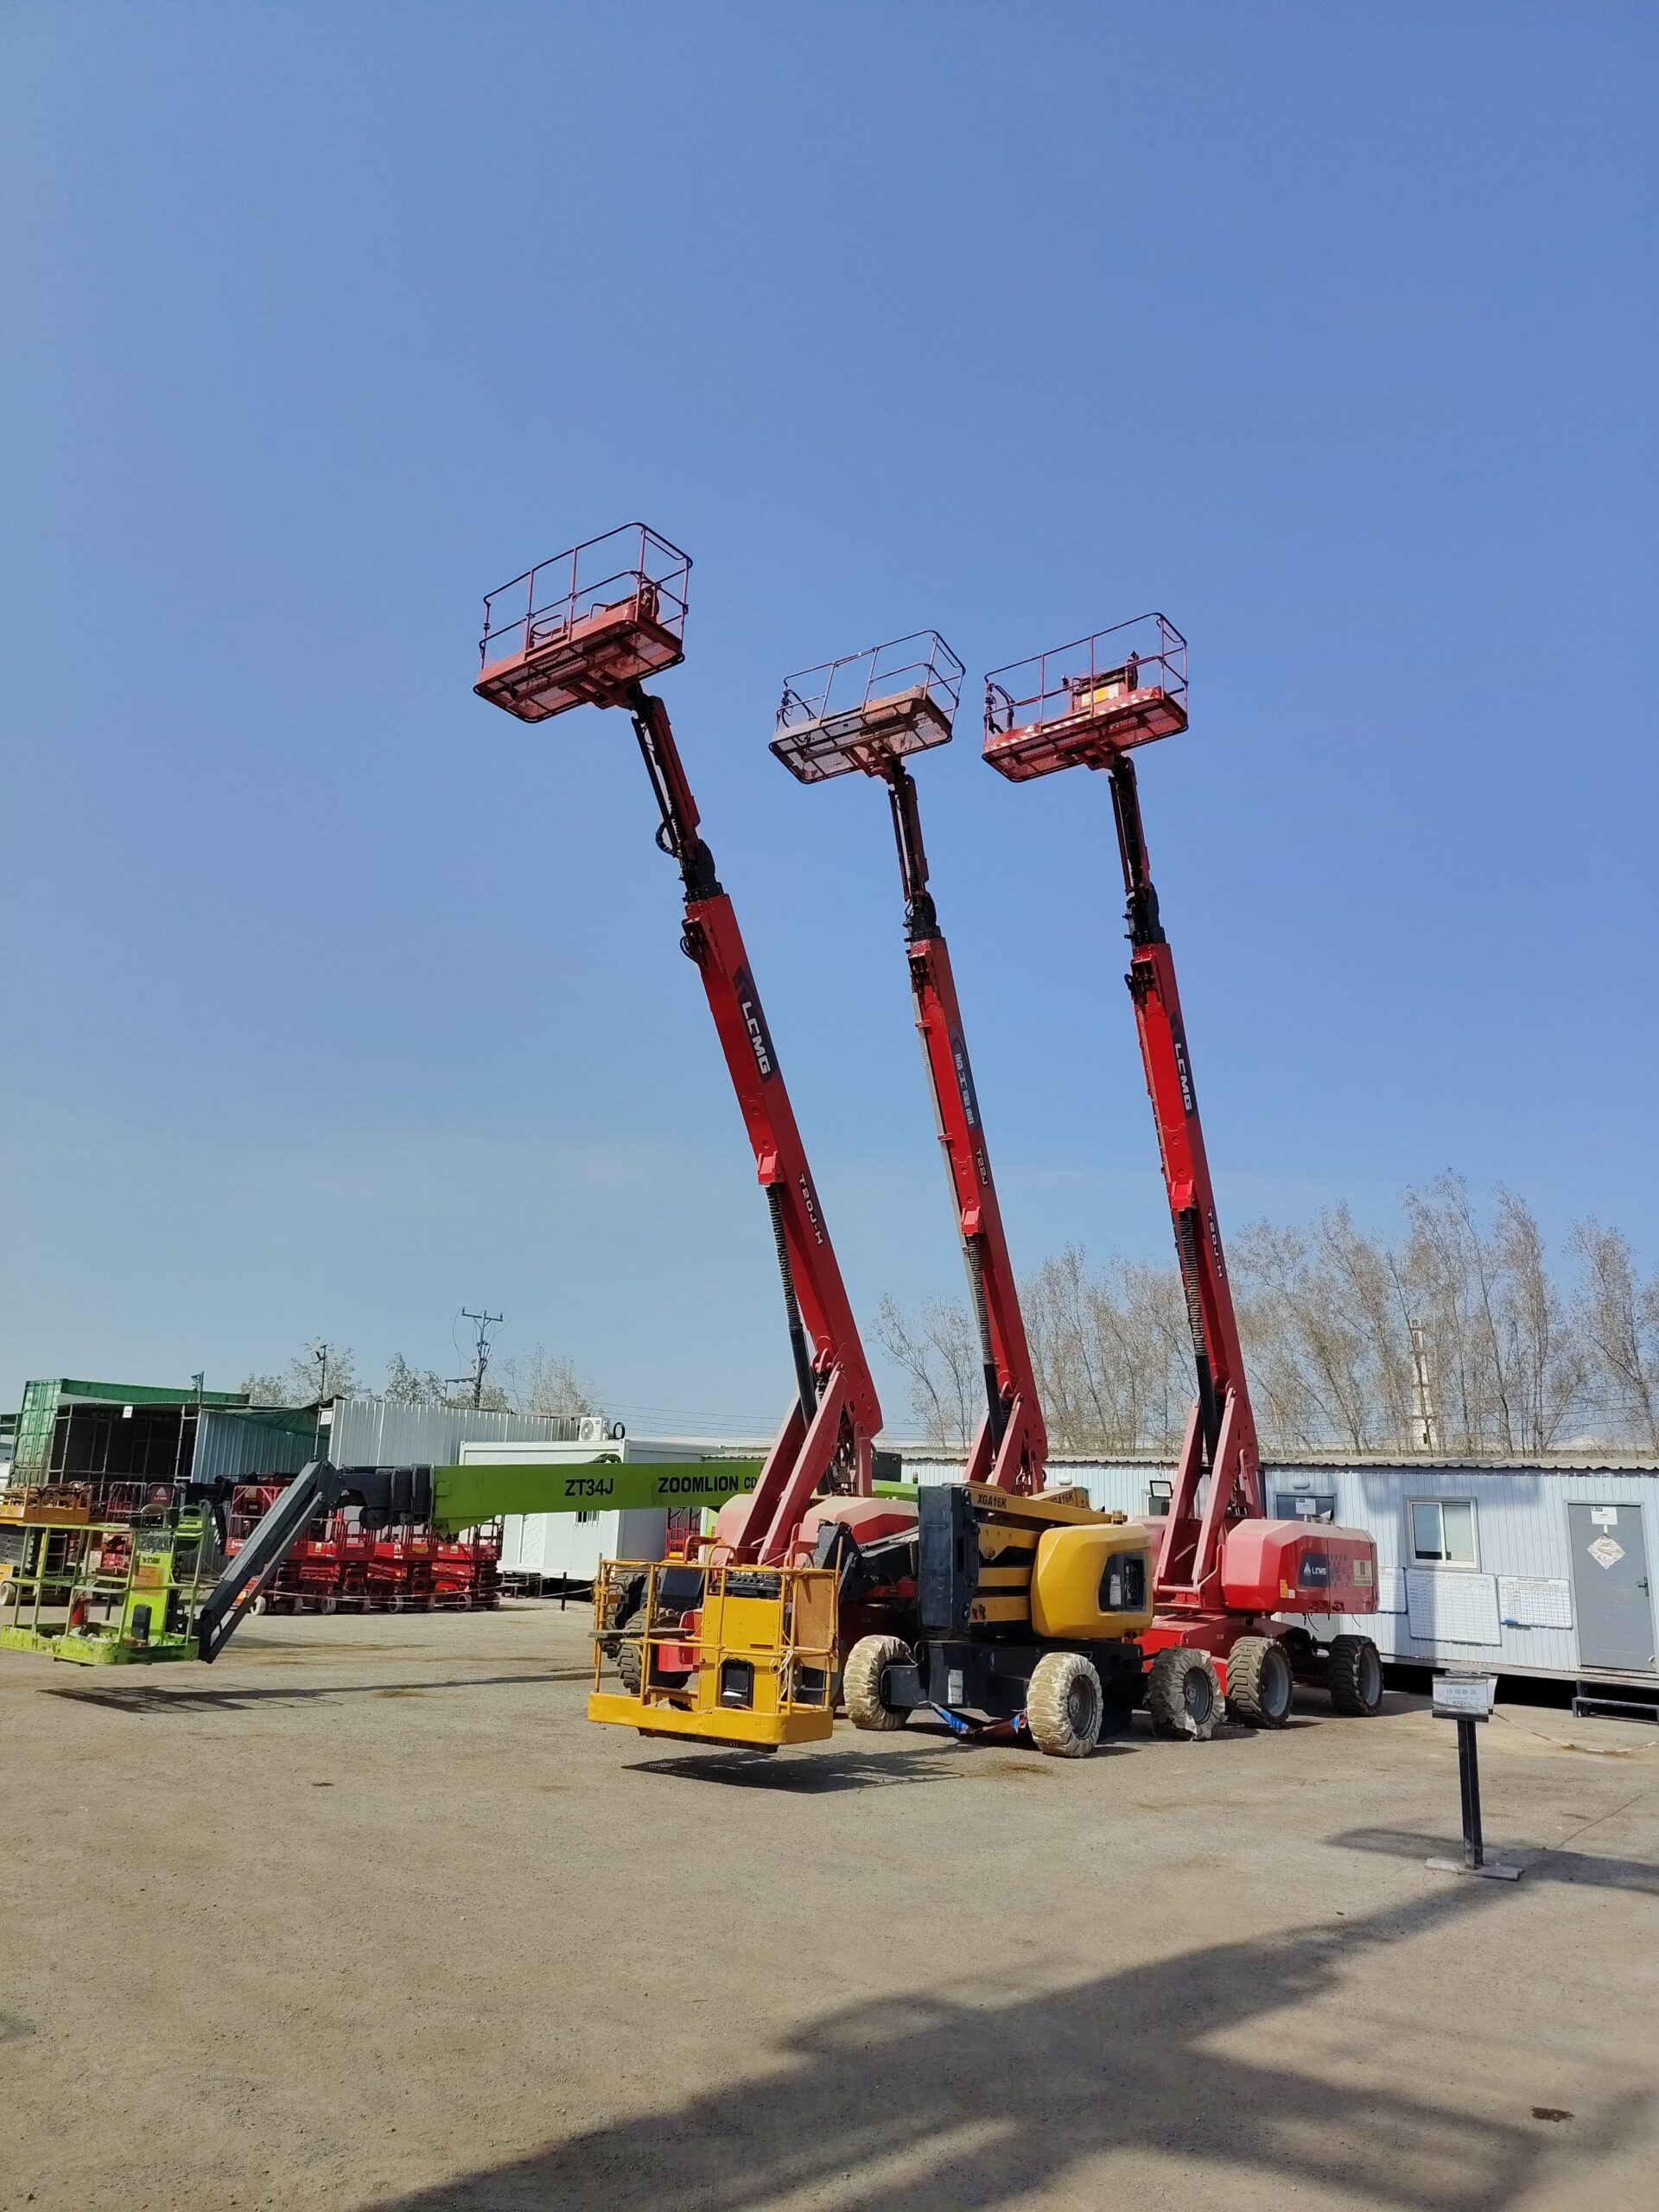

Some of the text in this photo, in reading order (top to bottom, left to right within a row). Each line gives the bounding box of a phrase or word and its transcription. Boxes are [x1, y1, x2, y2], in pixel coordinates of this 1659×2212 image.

[564, 1478, 613, 1496] ZT34J
[658, 1475, 759, 1493] ZOOMLION CD
[977, 1493, 1007, 1509] XGA16K
